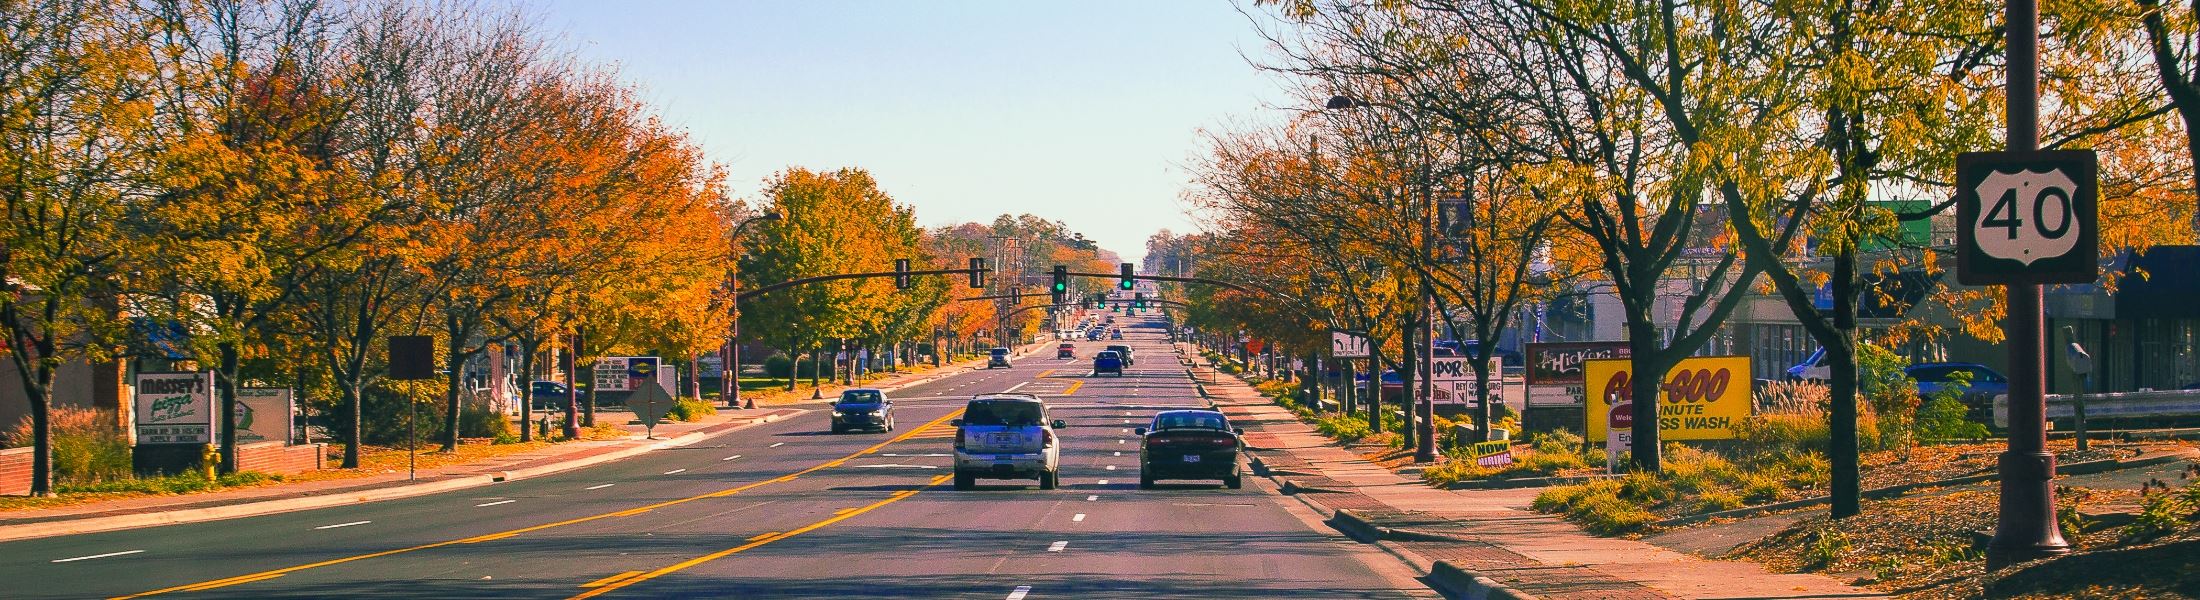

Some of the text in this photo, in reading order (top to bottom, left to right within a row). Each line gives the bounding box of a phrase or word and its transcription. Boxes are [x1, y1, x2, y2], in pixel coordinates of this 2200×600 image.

[1981, 186, 2071, 240] 40
[141, 374, 204, 394] MASSEY'S
[151, 394, 193, 417] pizza
[1660, 404, 1704, 415] INUTE
[1685, 416, 1730, 430] WASH
[1477, 443, 1507, 456] NOW
[1477, 453, 1511, 466] HIRING
